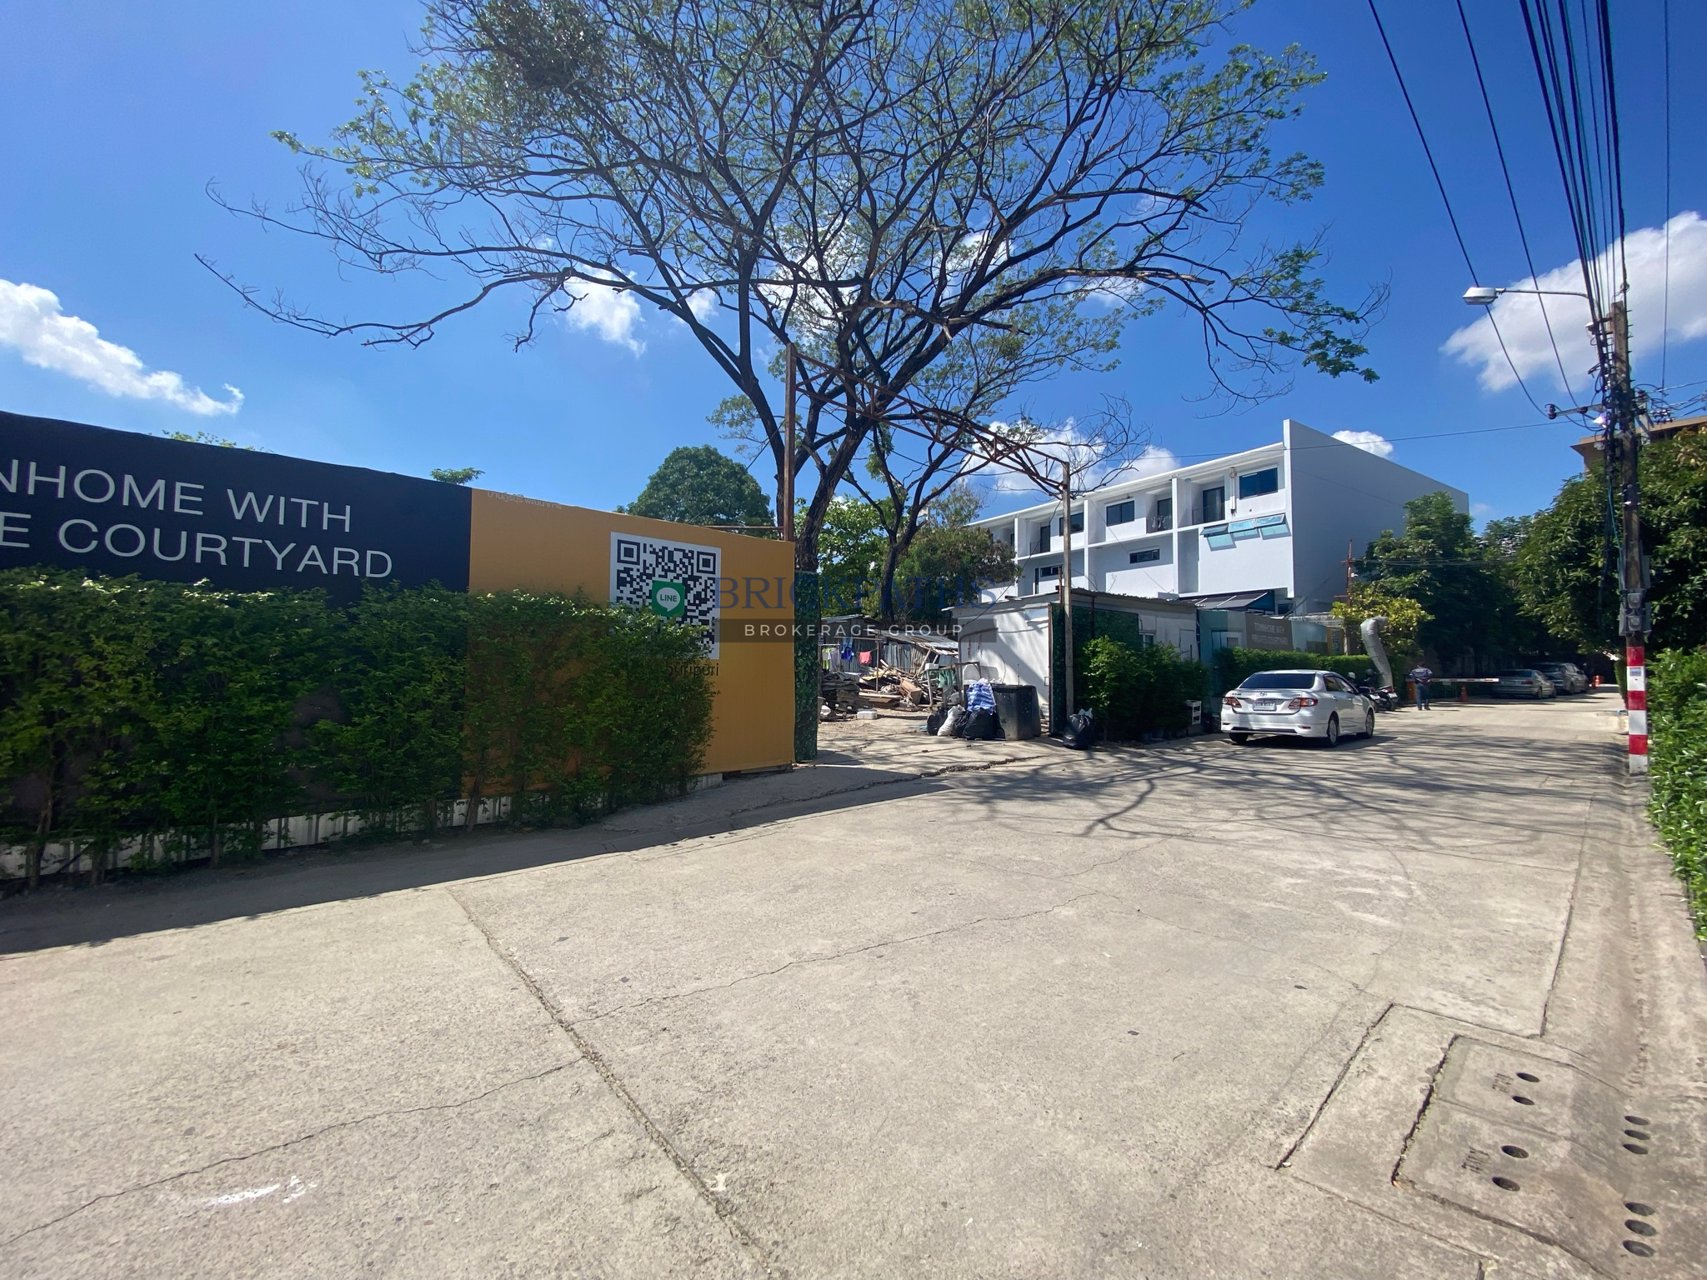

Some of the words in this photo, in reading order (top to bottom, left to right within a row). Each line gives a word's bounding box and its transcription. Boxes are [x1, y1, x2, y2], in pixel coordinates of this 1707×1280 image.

[227, 488, 352, 533] WITH
[0, 511, 32, 549] E
[58, 518, 394, 579] COURTYARD
[660, 594, 678, 602] LINE
